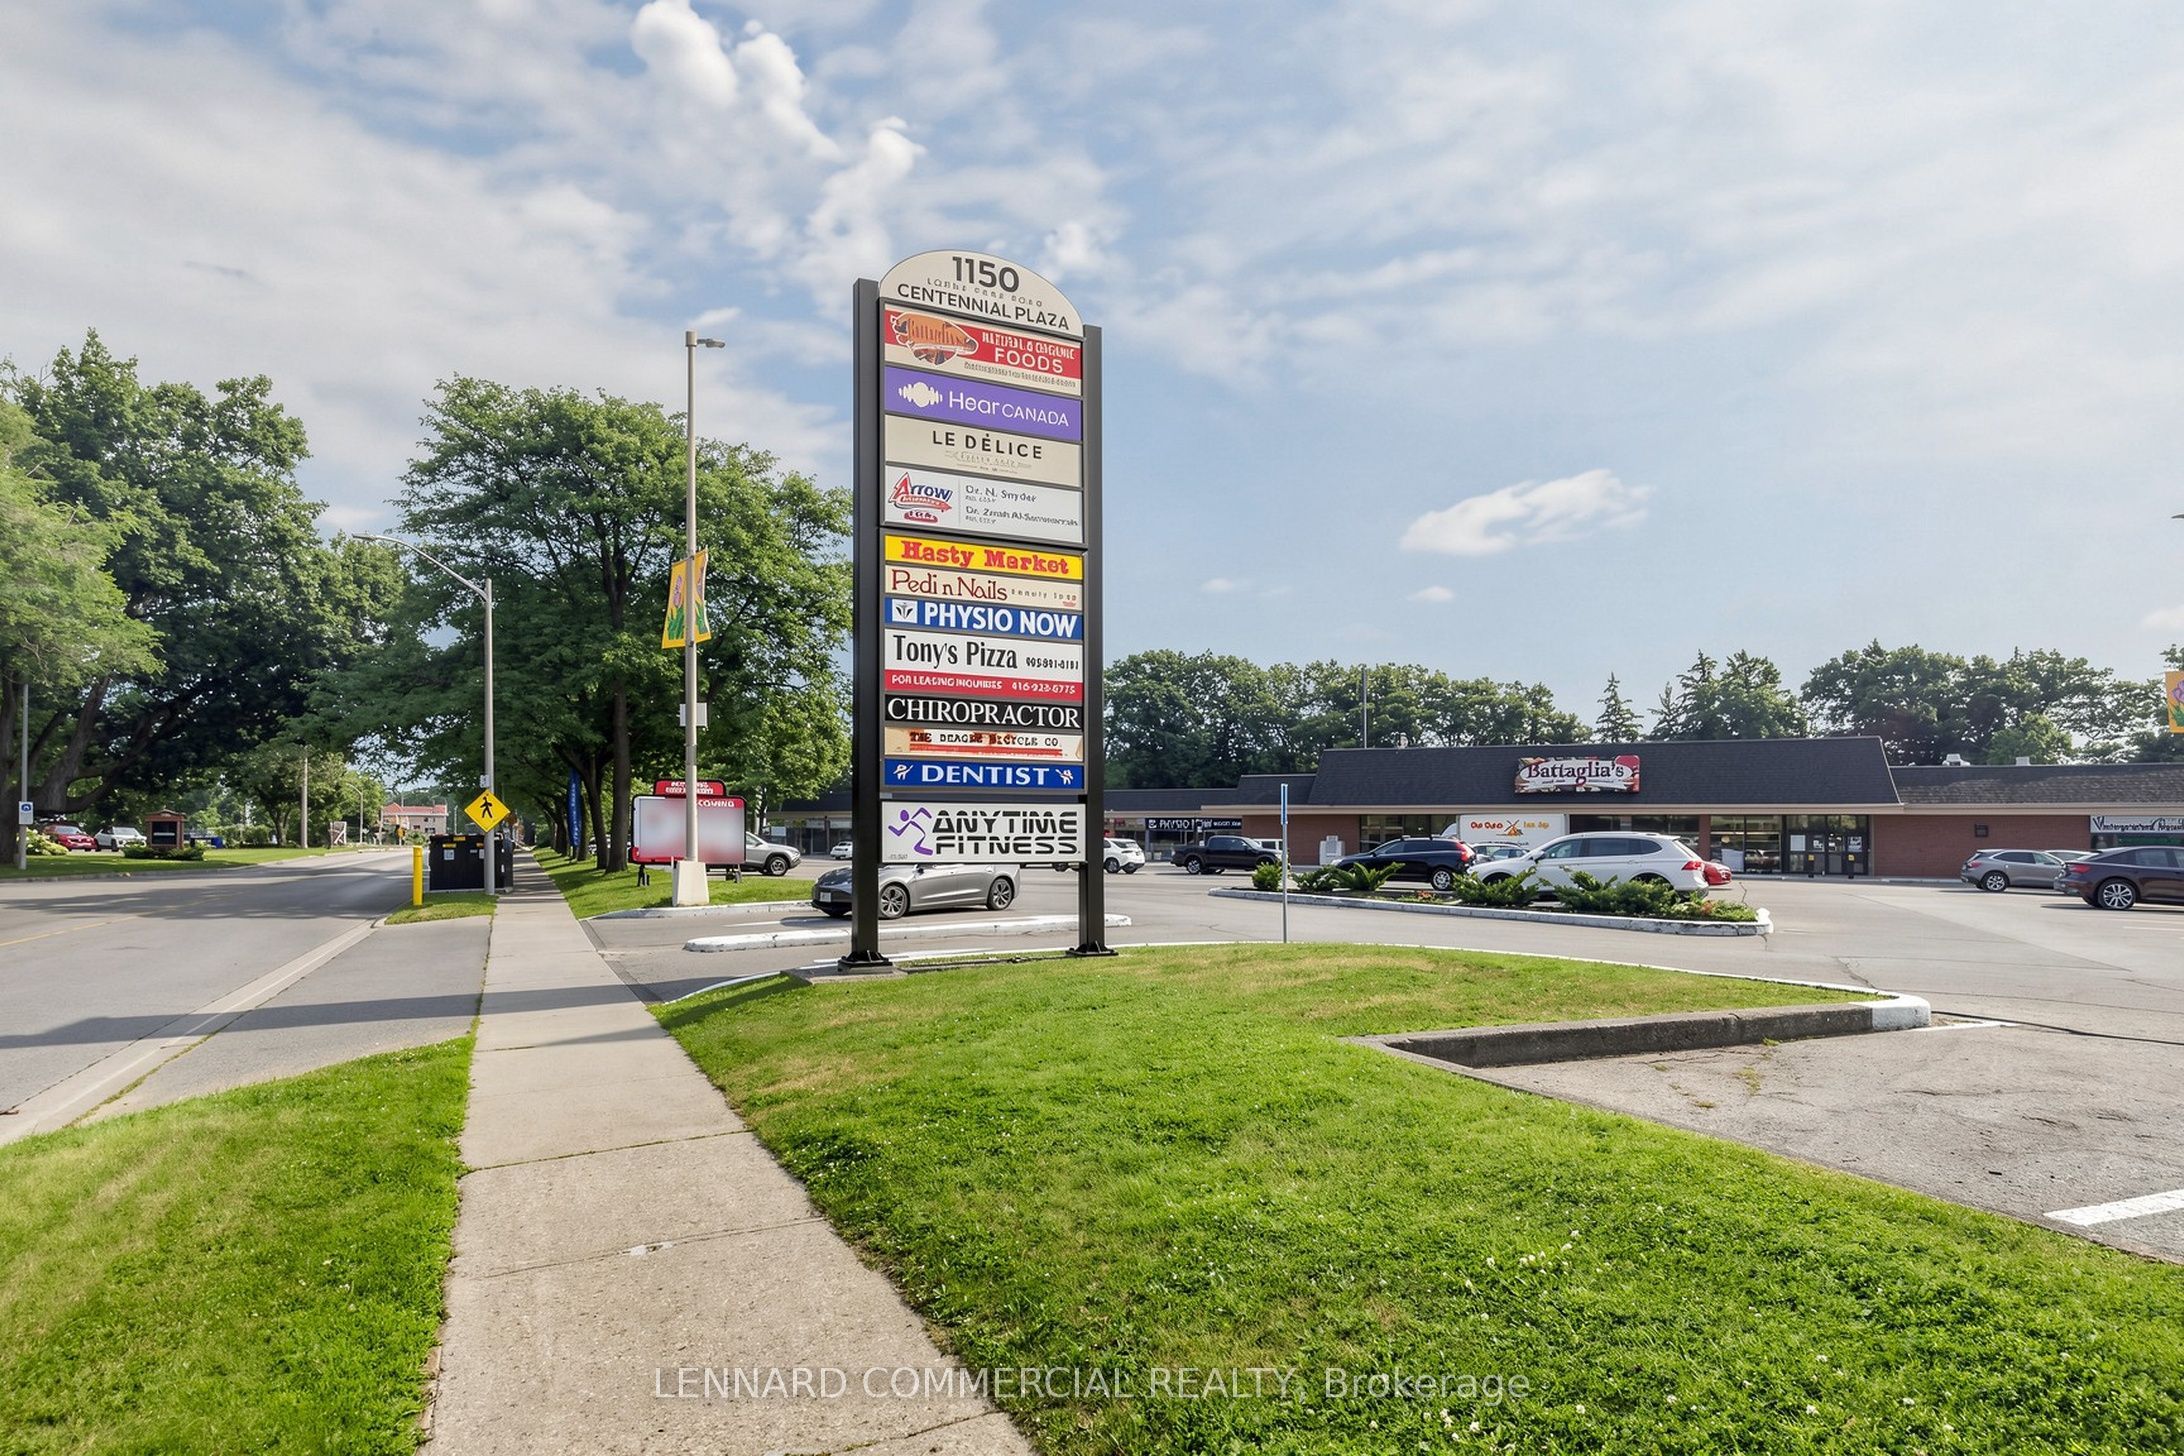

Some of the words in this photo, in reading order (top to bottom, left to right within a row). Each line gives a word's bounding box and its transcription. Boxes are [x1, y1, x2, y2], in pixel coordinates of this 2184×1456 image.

[952, 256, 1020, 293] 1150
[897, 283, 1012, 320] CENTENNIAL
[1015, 306, 1069, 331] PLAZA
[994, 347, 1064, 374] FOODS
[932, 430, 956, 447] LE
[900, 540, 975, 568] Hasty
[984, 548, 1069, 575] Market
[891, 569, 938, 595] Pedi
[942, 582, 954, 596] n
[957, 576, 1008, 601] Nails
[924, 602, 1013, 632] PHYSIO
[1019, 610, 1078, 638] NOW
[893, 634, 958, 669] Tony's
[966, 641, 1018, 669] Pizza
[887, 697, 1081, 729] CHIROPRACTOR
[921, 764, 1050, 786] DENTIST
[1527, 761, 1625, 786] Battaglia's
[932, 809, 1078, 834] ANYTIME
[935, 836, 1079, 855] FITNESS
